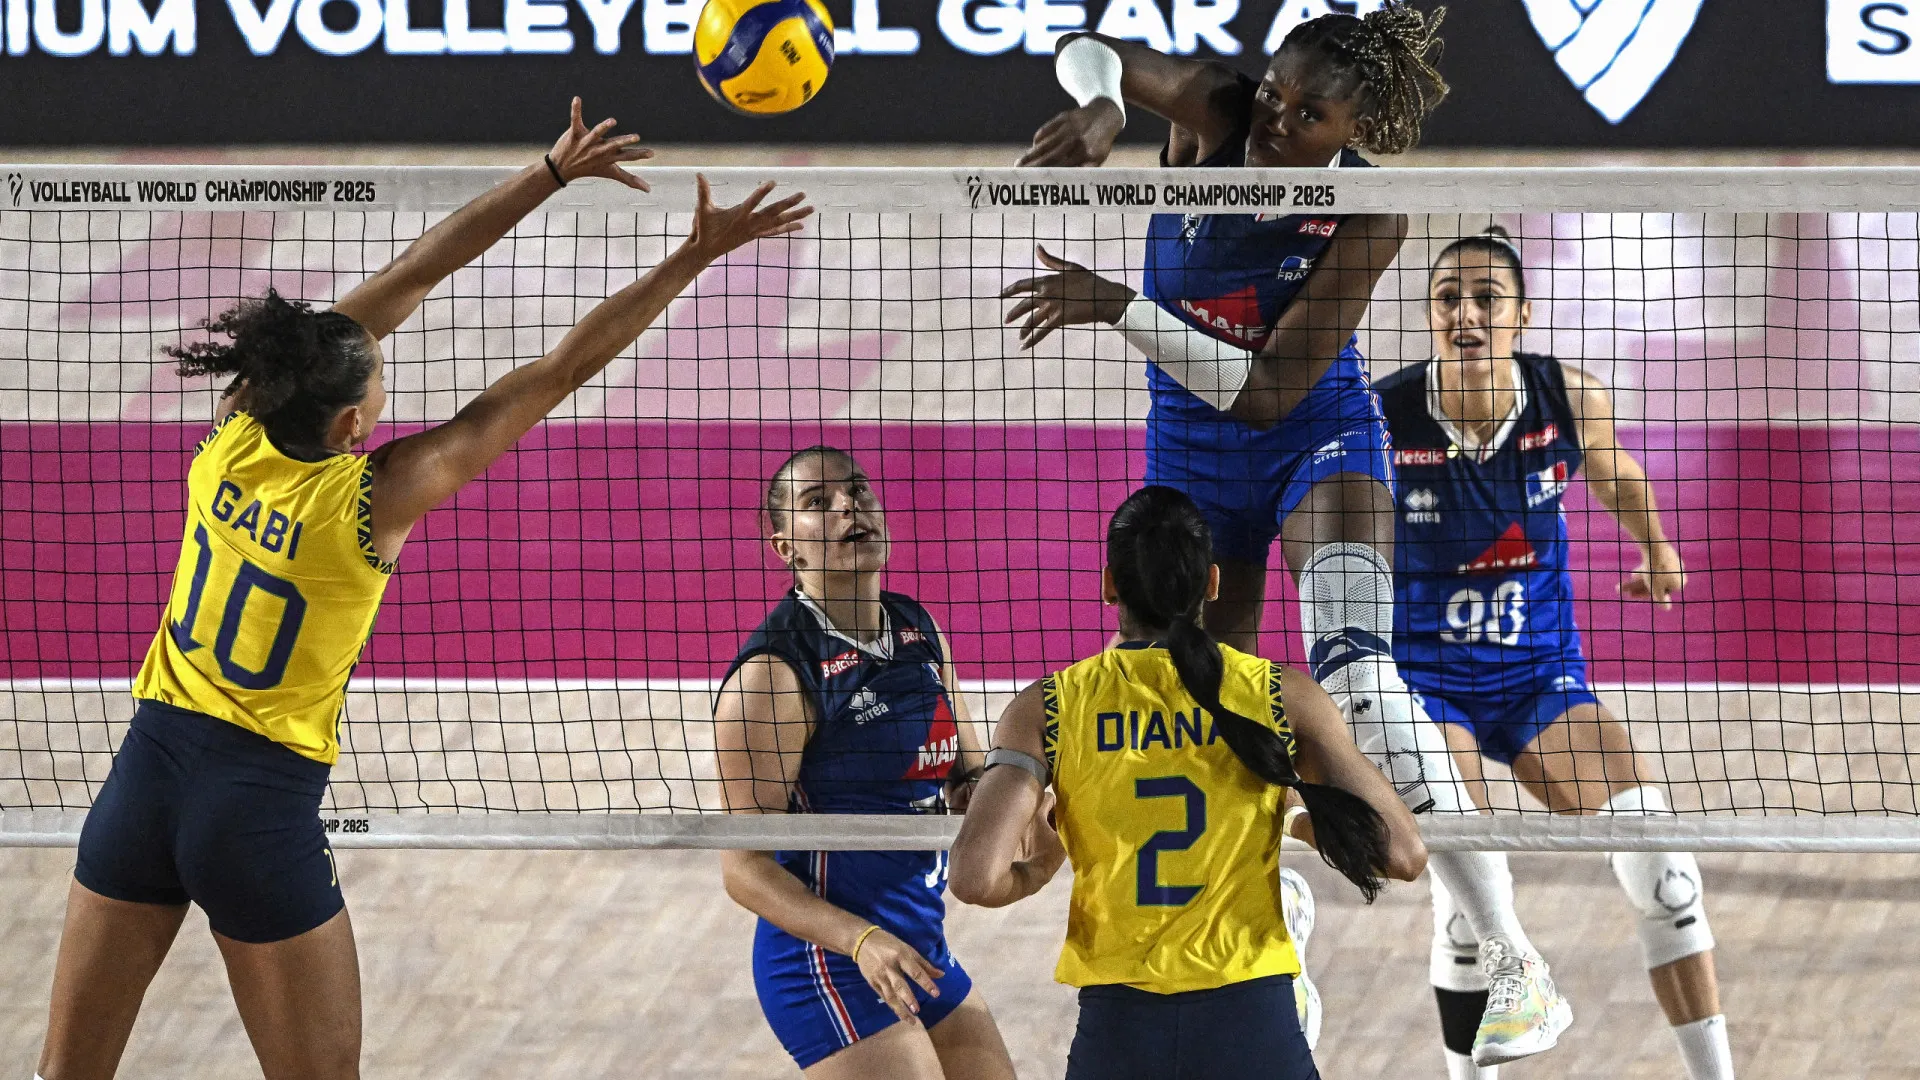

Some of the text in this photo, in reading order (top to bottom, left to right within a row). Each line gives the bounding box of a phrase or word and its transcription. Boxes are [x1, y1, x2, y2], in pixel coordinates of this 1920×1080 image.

[0, 0, 197, 56] IUM
[30, 180, 376, 202] VOLLEYBALL WORLD CHAMPIONSHIP 2025
[988, 184, 1335, 206] VOLLEYBALL WORLD CHAMPIONSHIP 2025
[211, 480, 303, 560] GABI
[172, 521, 307, 690] 10
[343, 819, 369, 833] 2025
[1135, 775, 1207, 907] 2
